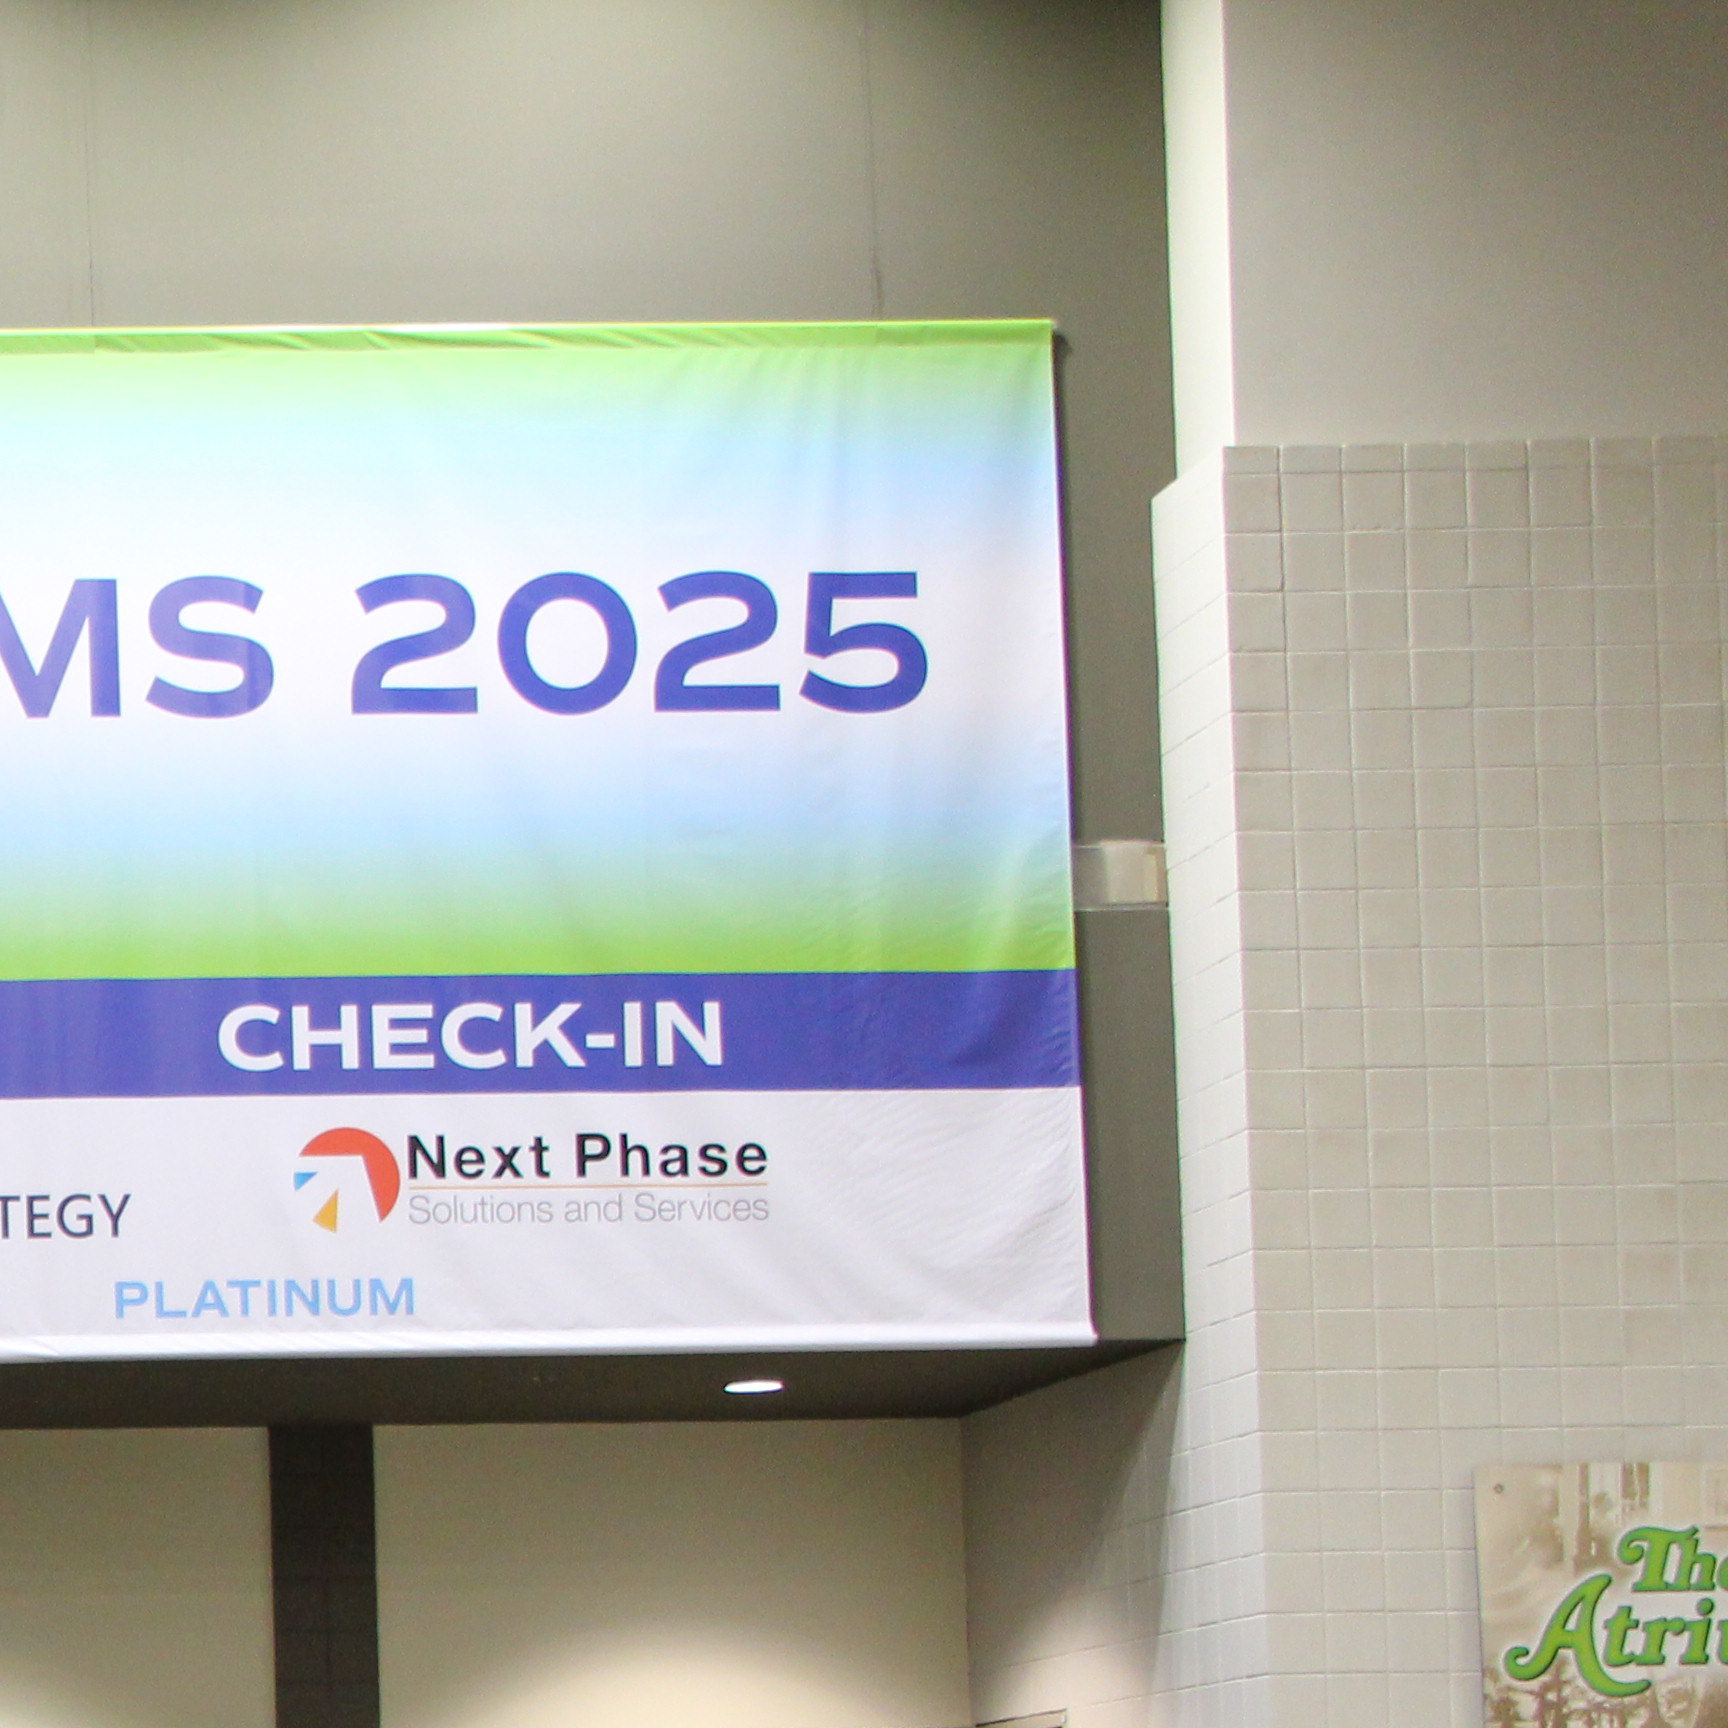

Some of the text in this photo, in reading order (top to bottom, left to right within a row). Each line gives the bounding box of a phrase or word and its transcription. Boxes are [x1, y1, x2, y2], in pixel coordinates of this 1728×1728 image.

[353, 570, 928, 714] 2025
[219, 1001, 722, 1070] CHECK-IN
[409, 1133, 767, 1178] Next Phase
[409, 1192, 770, 1224] Solutions and Services
[116, 1277, 414, 1318] PLATINUM
